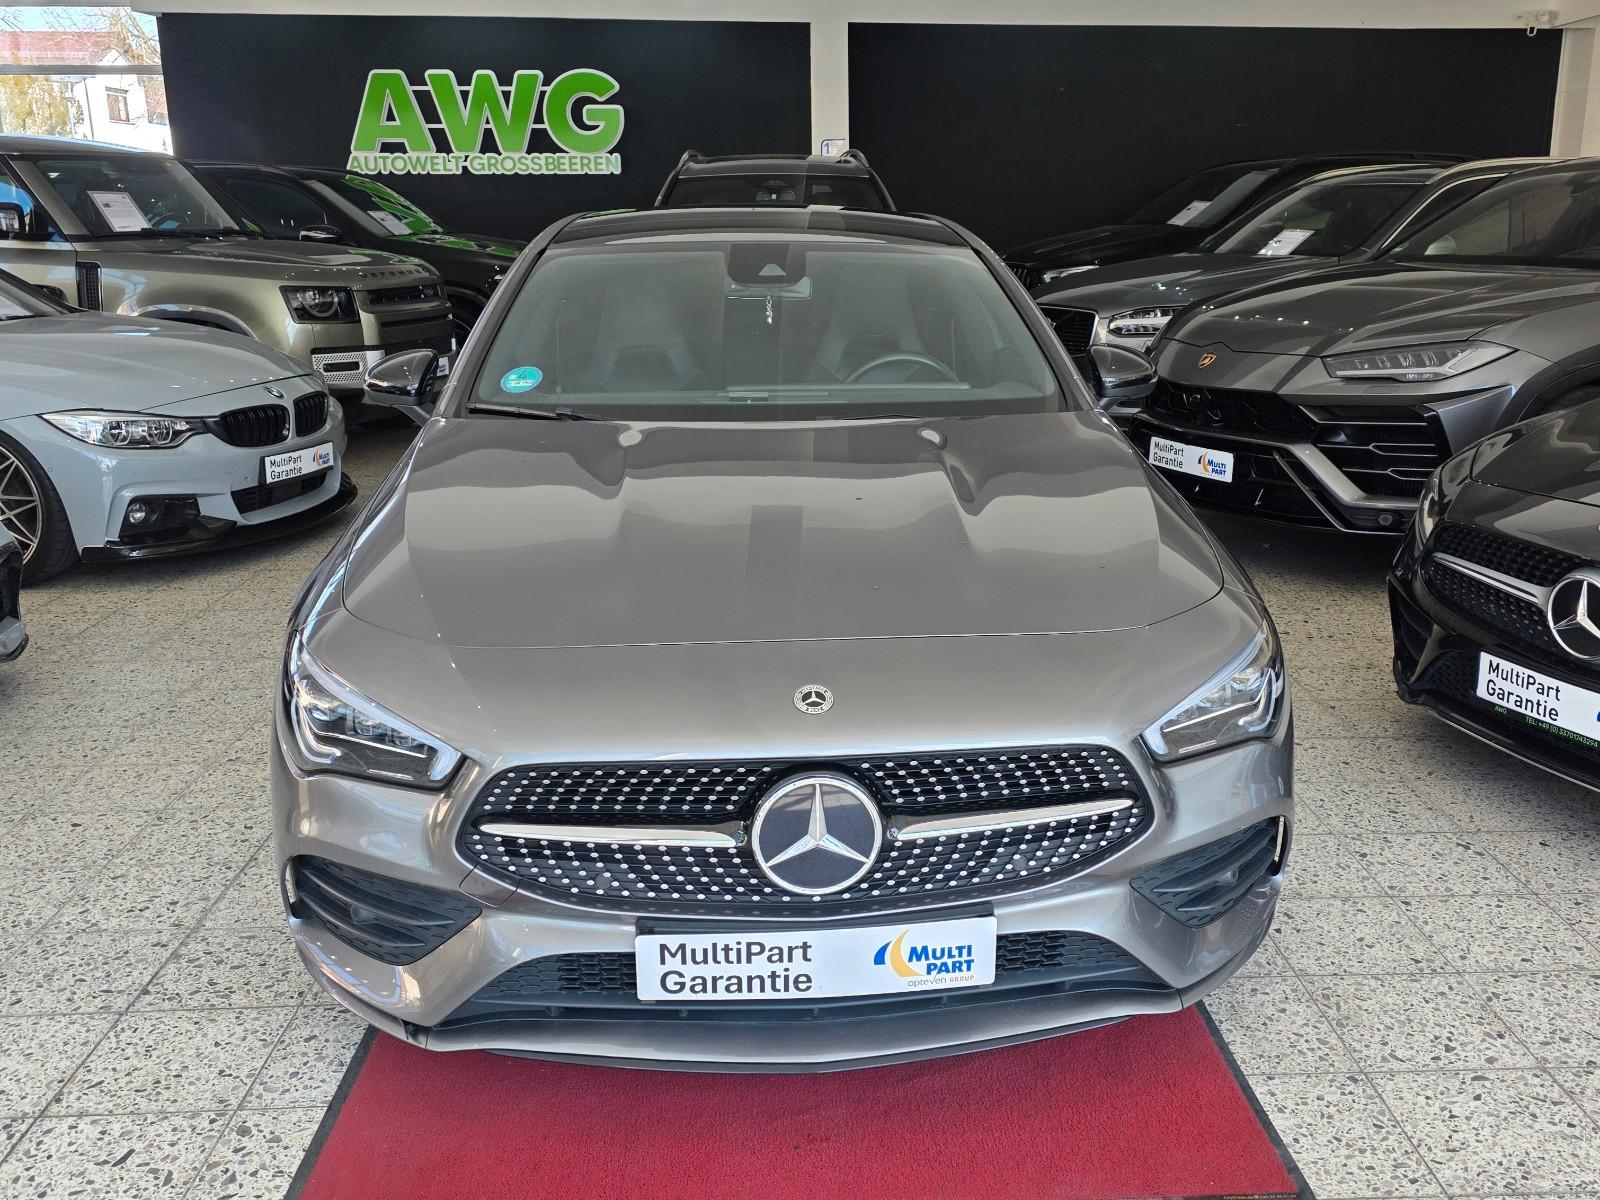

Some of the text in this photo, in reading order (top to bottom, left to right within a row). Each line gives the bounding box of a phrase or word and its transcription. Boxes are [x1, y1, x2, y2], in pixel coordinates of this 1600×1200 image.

[351, 68, 625, 154] AWG
[350, 153, 621, 174] AUTOWELT GROSSBEEREN
[1154, 441, 1183, 456] MultiPart
[270, 455, 302, 469] MultiPart
[1153, 452, 1183, 468] Garantie
[1207, 459, 1226, 469] MULTI
[270, 465, 302, 479] Garantie
[1212, 467, 1226, 476] PART
[1488, 660, 1560, 701] MultiPart
[1486, 679, 1559, 722] Garantie
[1494, 705, 1507, 714] AWG
[659, 941, 813, 966] MultiPart
[907, 944, 973, 963] MULTI
[926, 959, 975, 976] PART
[659, 967, 813, 995] Garantie
[907, 974, 975, 988] opteven GROUP
